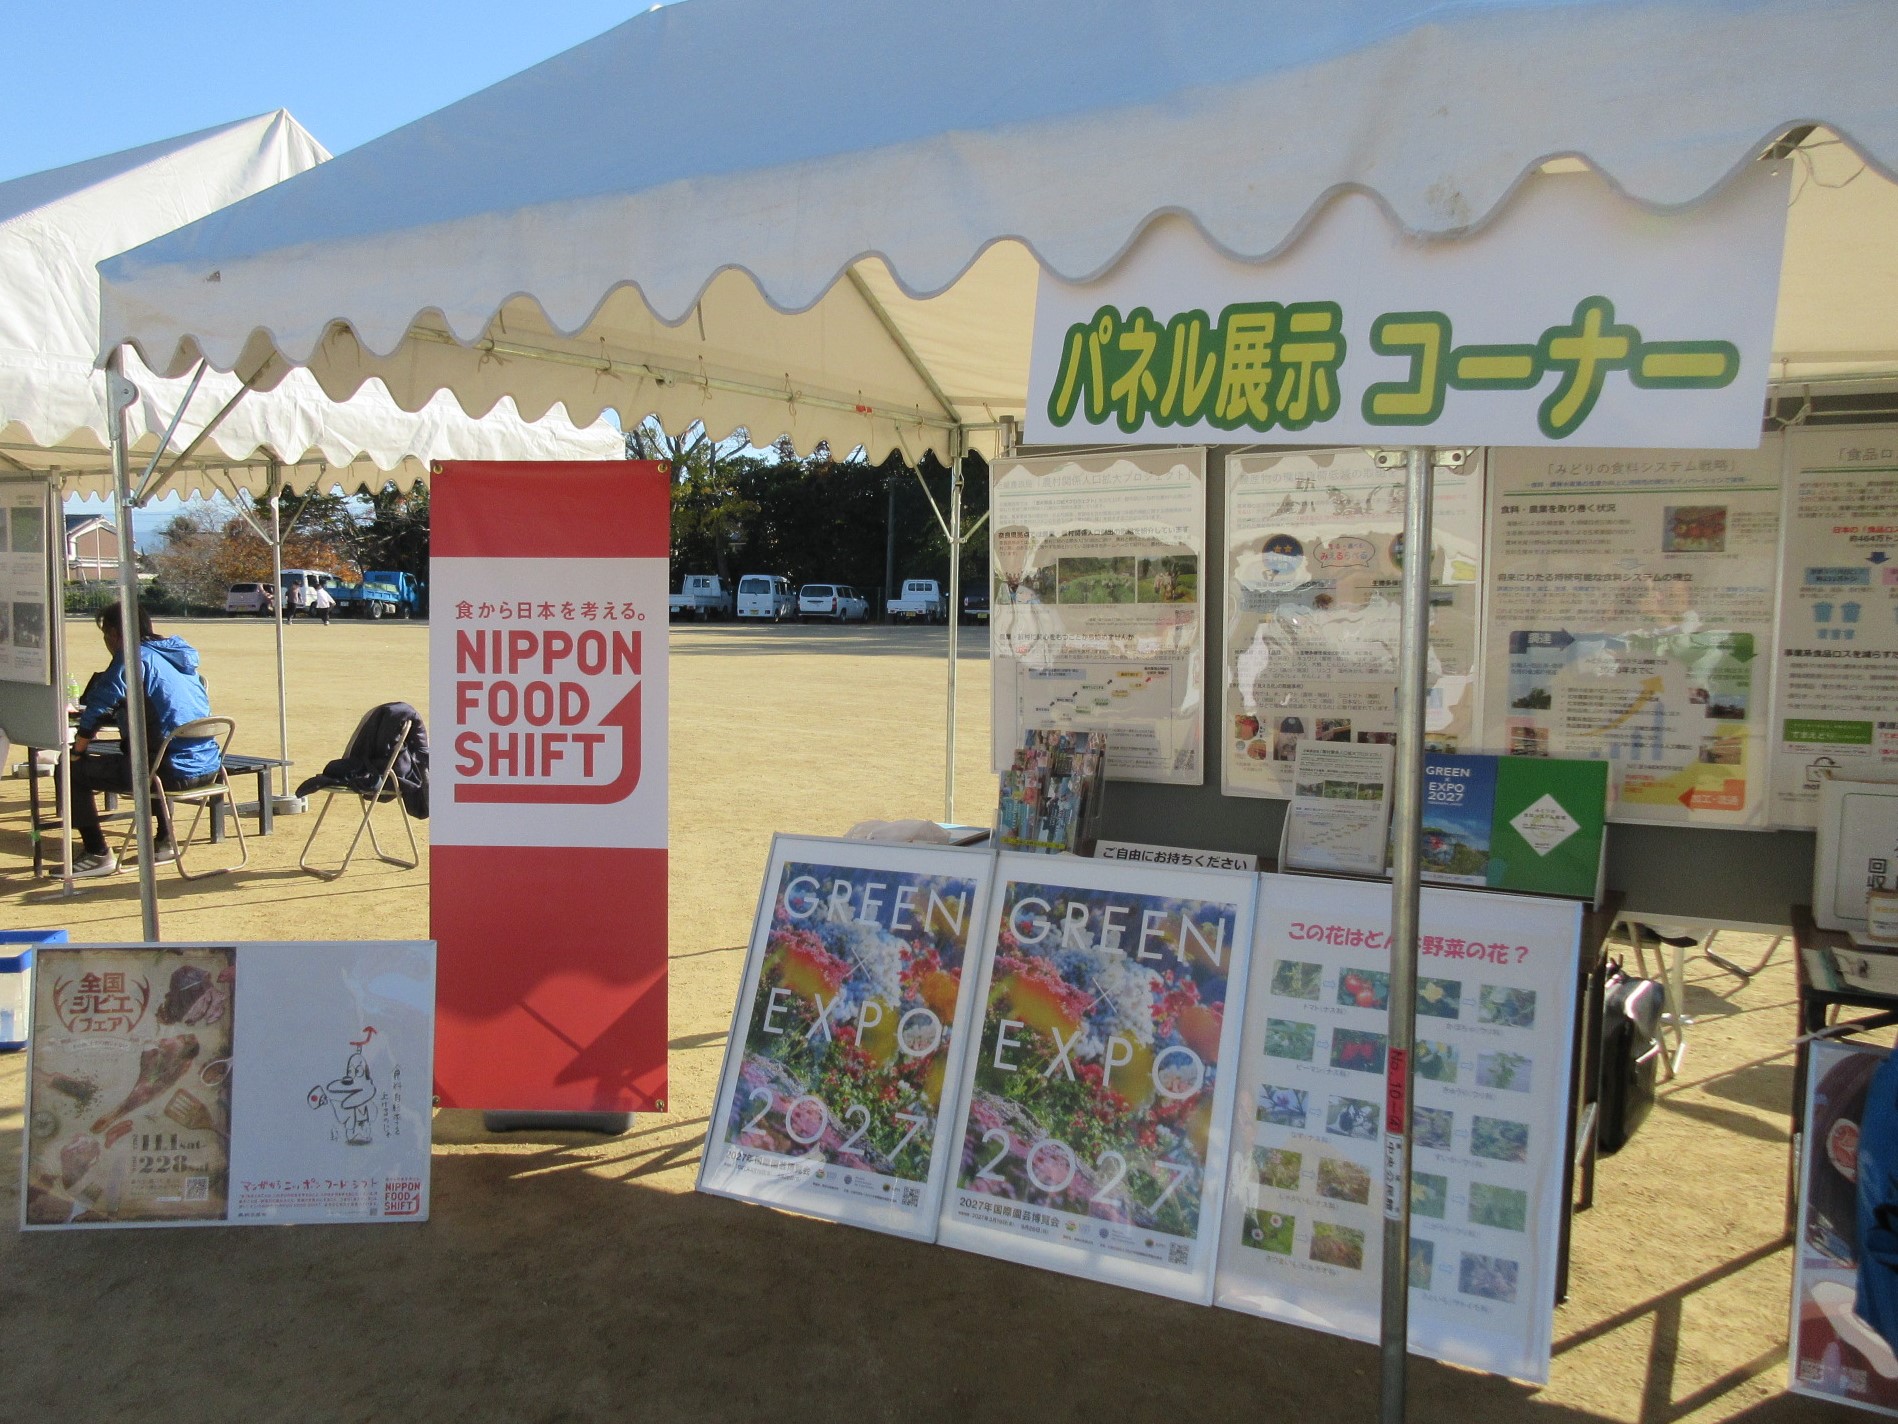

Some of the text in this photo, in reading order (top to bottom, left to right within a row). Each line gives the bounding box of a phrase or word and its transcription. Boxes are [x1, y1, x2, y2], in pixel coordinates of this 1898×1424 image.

[1048, 295, 1740, 440] パネル展示 コーナー
[1840, 447, 1898, 461] 「食品ロ
[455, 600, 646, 621] 食から日本を考える。
[456, 629, 642, 676] NIPPON
[456, 680, 590, 727] FOOD
[454, 731, 606, 777] SHIFT
[1425, 766, 1471, 777] GREEN
[1428, 791, 1463, 802] 2027
[1429, 782, 1465, 793] EXPO
[1103, 847, 1248, 871] ご自由にお持ちください
[784, 875, 967, 935] GREEN
[1009, 897, 1226, 967] GREEN
[78, 972, 125, 994] 全国
[69, 994, 134, 1015] ジビエ
[79, 1016, 123, 1033] フェア
[763, 987, 942, 1058] EXPO
[993, 1018, 1206, 1100] EXPO
[741, 1086, 928, 1163] 2027
[975, 1128, 1193, 1216] 2027
[385, 1182, 420, 1191] NIPPON
[385, 1192, 411, 1201] FOOD
[384, 1202, 413, 1210] SHIFT
[959, 1196, 1061, 1229] 2027年国際園芸博覧会
